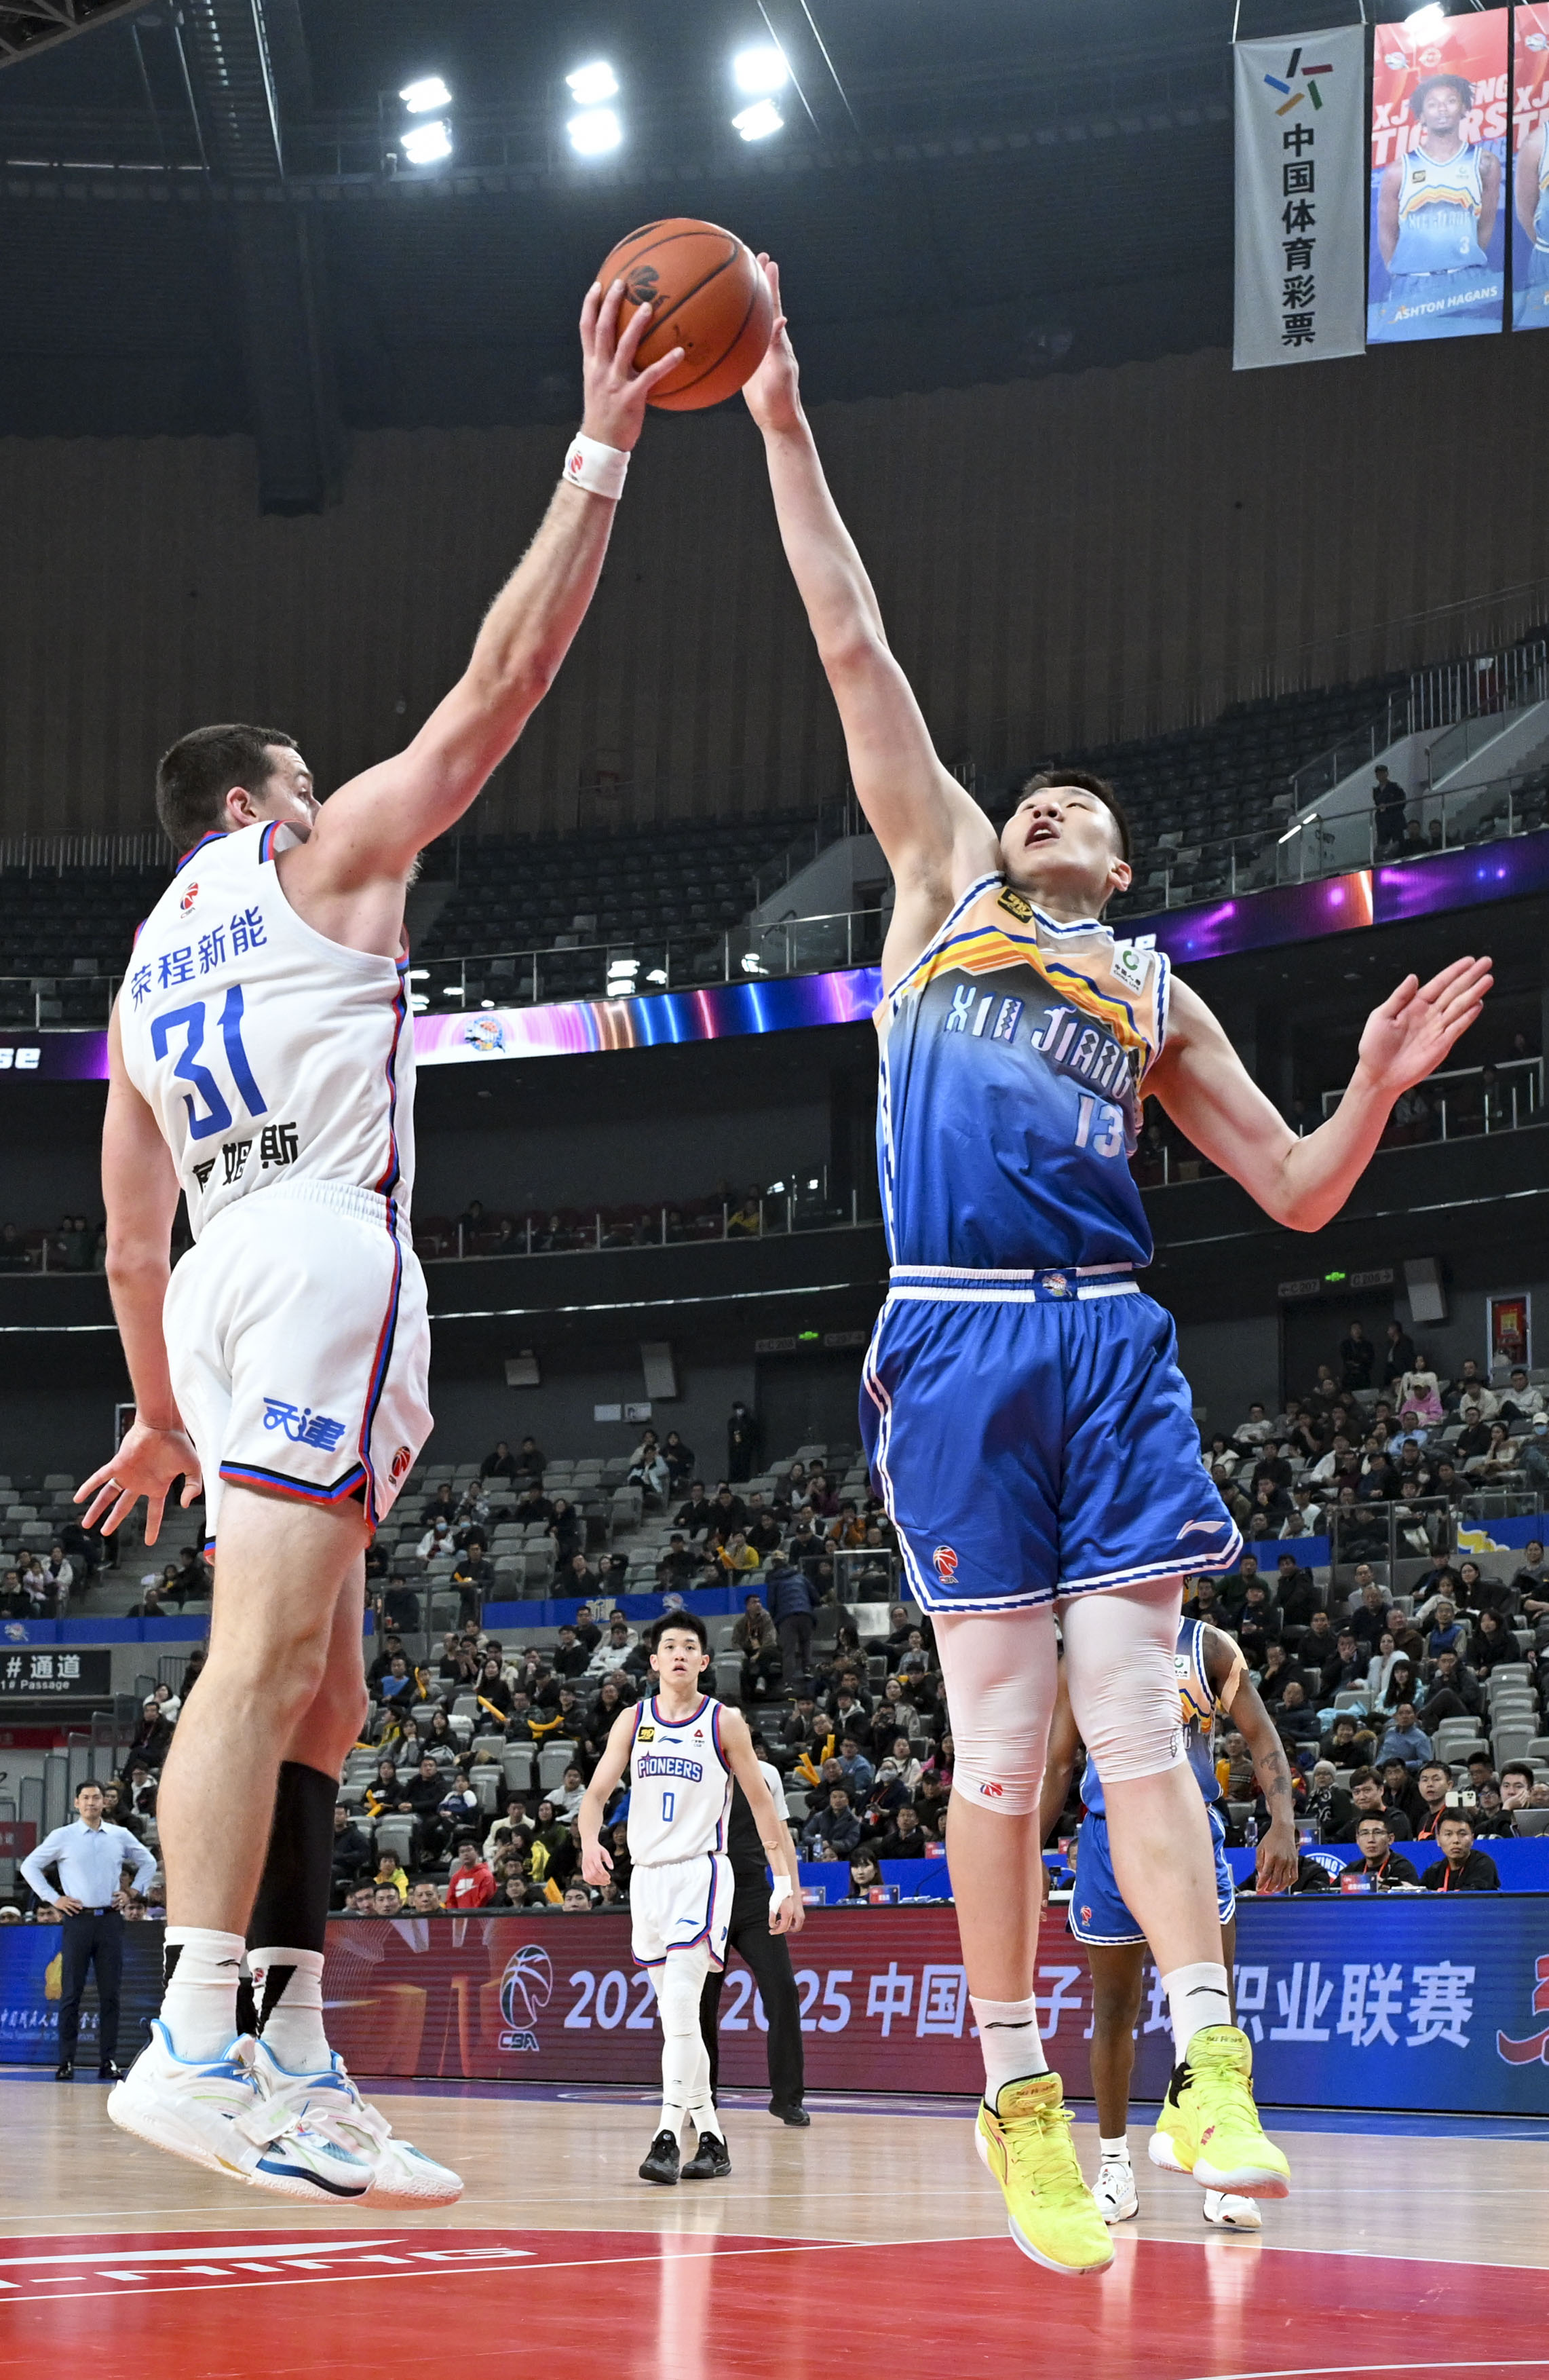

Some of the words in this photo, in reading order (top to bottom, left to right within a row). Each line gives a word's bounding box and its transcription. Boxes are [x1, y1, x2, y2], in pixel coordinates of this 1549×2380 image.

[1371, 101, 1508, 165] TIGRS
[1282, 123, 1316, 347] 中国体育彩票
[1459, 235, 1470, 254] 3
[1394, 301, 1445, 322] ASHTON
[1447, 286, 1498, 305] HAGANS
[130, 905, 268, 1013] 荣程新能
[151, 983, 268, 1141] 31
[1074, 1093, 1124, 1158] 13
[20, 1679, 70, 1690] Passage
[31, 1654, 81, 1679] 通道
[662, 1792, 674, 1822] 0
[498, 2030, 539, 2051] CBA
